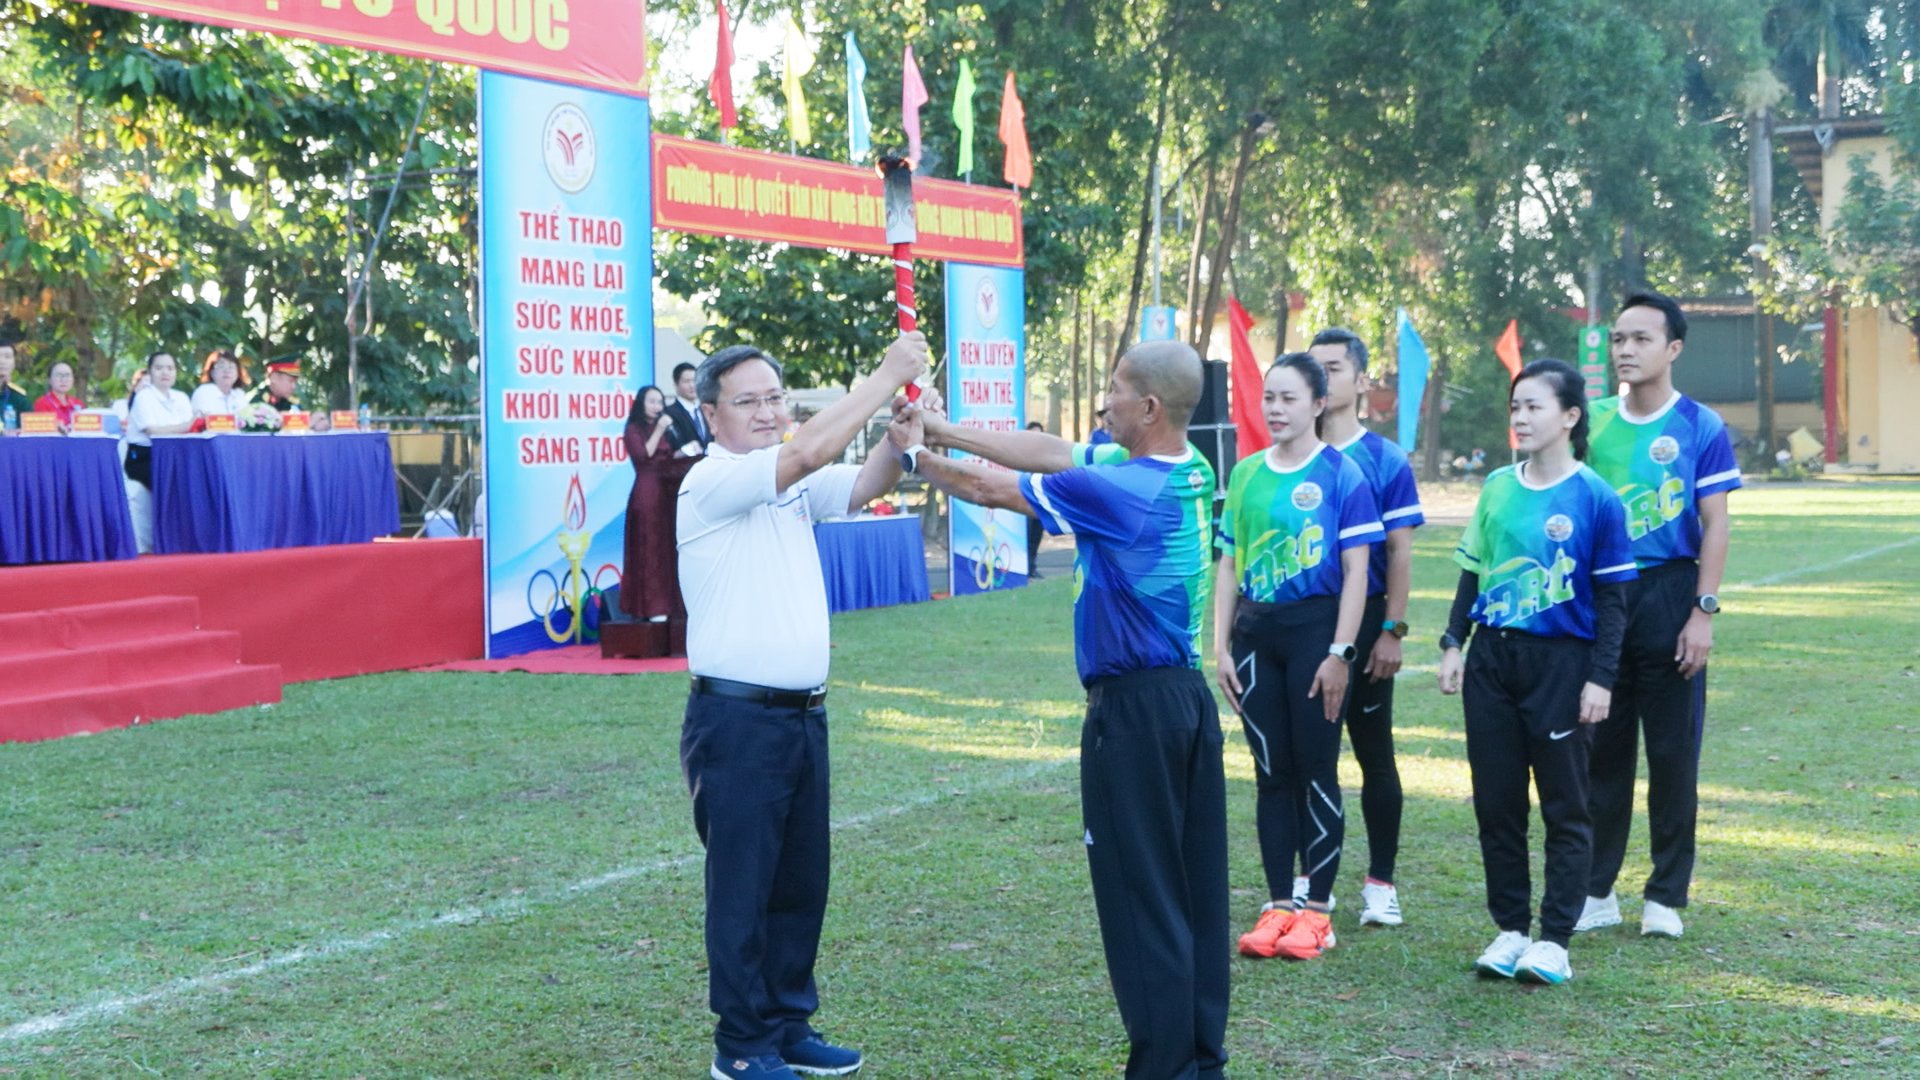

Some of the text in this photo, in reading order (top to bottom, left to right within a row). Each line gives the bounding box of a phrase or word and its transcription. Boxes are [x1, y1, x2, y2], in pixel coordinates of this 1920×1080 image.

[568, 217, 622, 247] THAO
[521, 257, 585, 288] MANG
[517, 299, 562, 331] SỨC
[519, 344, 564, 376] SỨC
[521, 433, 580, 465] SÁNG
